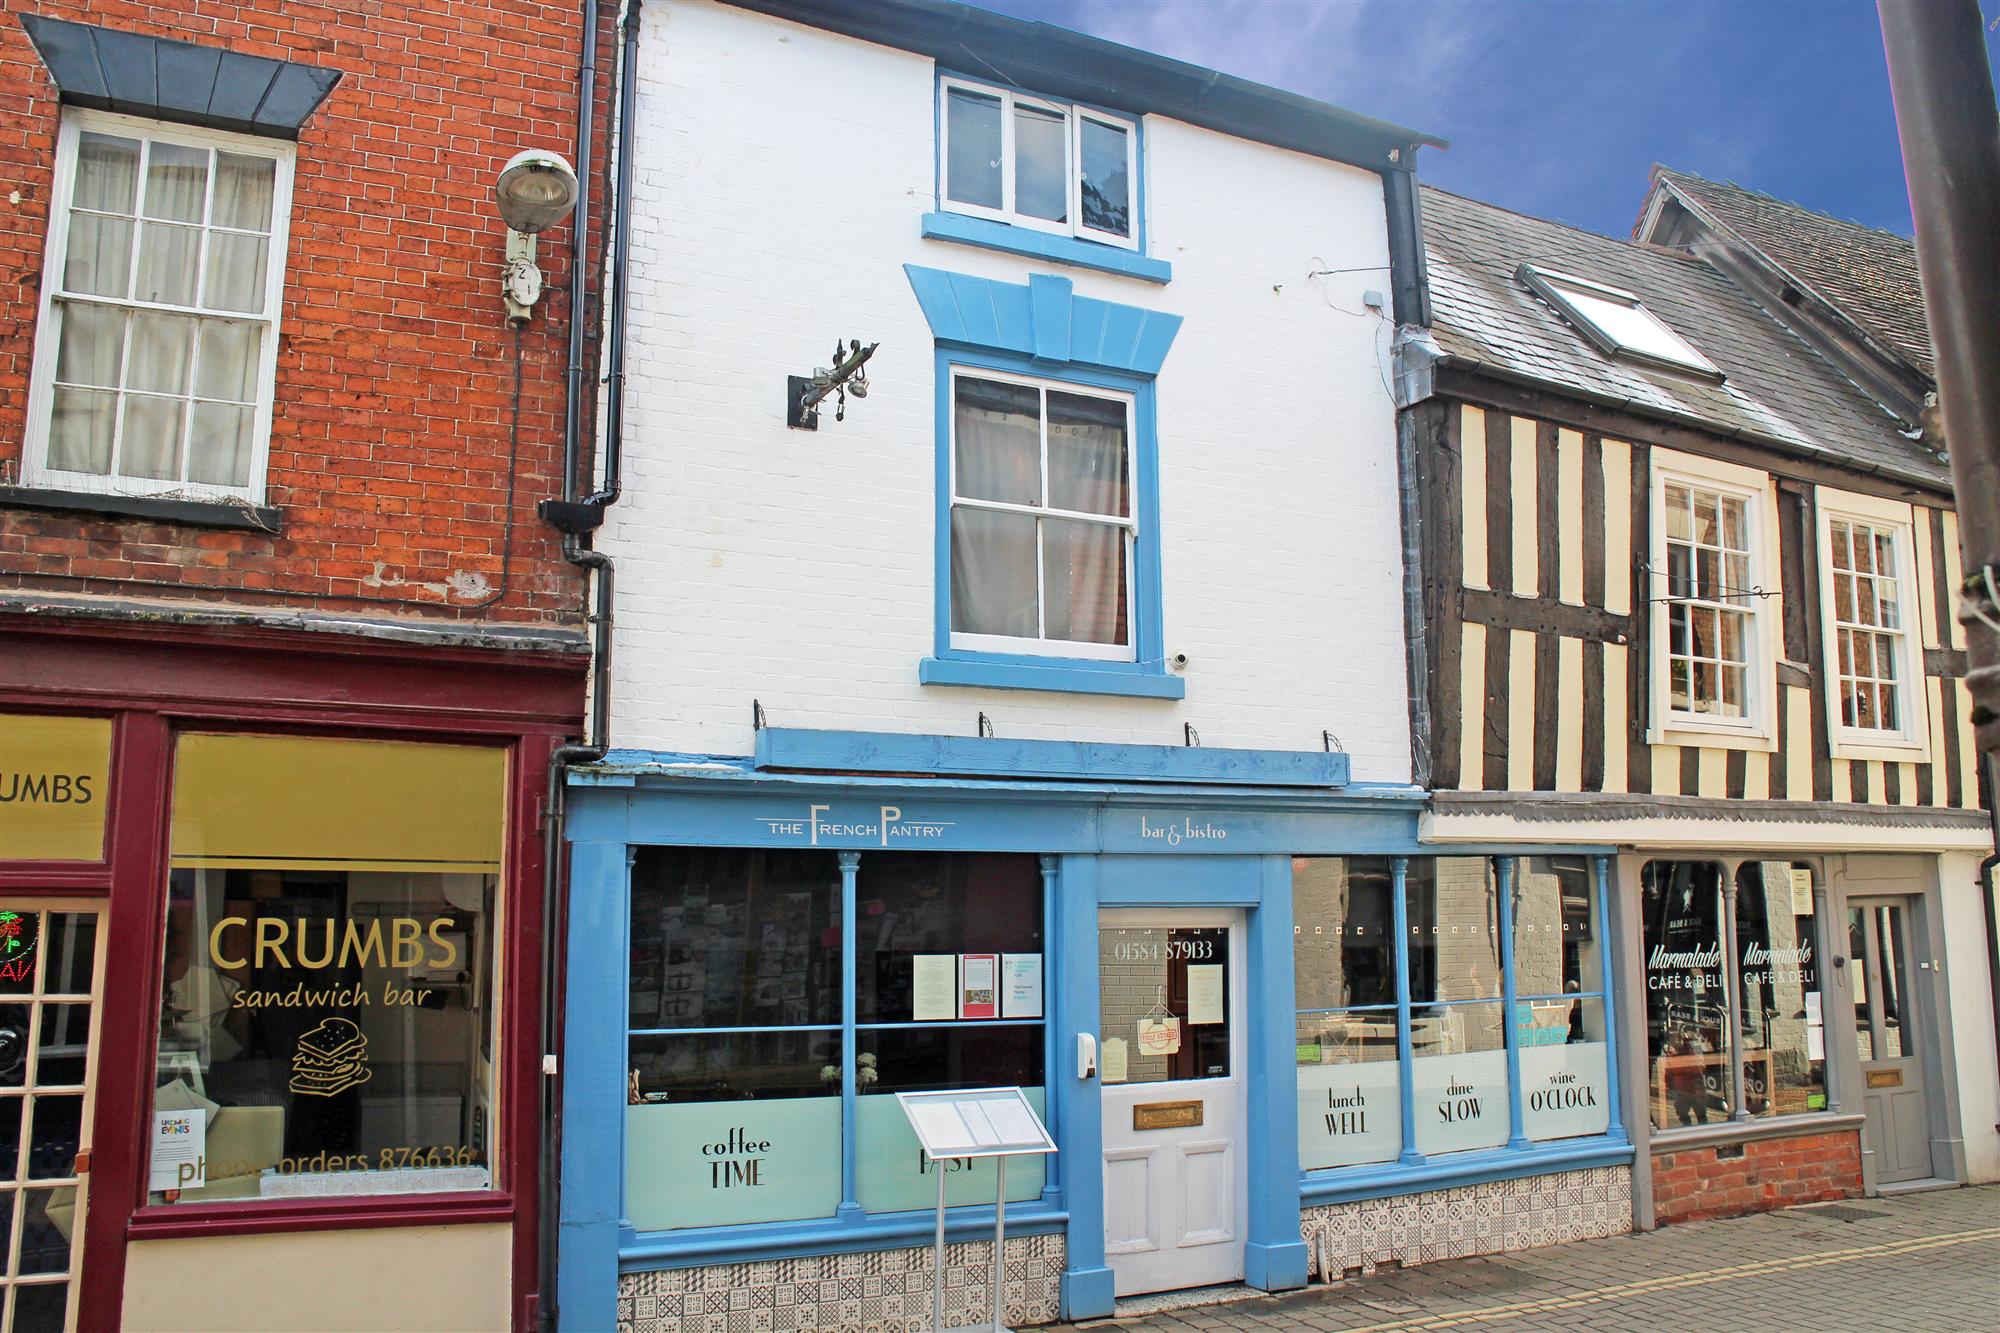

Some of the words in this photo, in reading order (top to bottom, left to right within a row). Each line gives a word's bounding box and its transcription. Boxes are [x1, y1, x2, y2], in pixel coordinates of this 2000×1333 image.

[768, 823, 803, 835] THE
[810, 804, 877, 845] FRENCH
[880, 806, 944, 847] PANTRY
[1142, 816, 1166, 838] bar
[1167, 824, 1183, 846] &
[1185, 816, 1226, 839] bistro
[209, 916, 457, 969] CRUMBS
[1114, 941, 1158, 961] 01584
[1165, 940, 1213, 960] 879133
[1649, 941, 1721, 970] Marmalade
[1743, 938, 1812, 966] Marmalade
[1649, 973, 1681, 990] CAFÉ
[1684, 977, 1693, 988] &
[1696, 974, 1723, 988] DELI
[1744, 969, 1774, 985] CAFÉ
[1777, 973, 1785, 983] &
[1789, 969, 1814, 983] DELI
[232, 981, 370, 1009] sandwich
[383, 980, 432, 1007] bar
[1446, 1075, 1474, 1096] dine
[1549, 1071, 1576, 1085] wine
[1328, 1084, 1365, 1109] lunch
[1530, 1086, 1597, 1112] O'CLOCK
[1325, 1110, 1370, 1136] WELL
[1438, 1097, 1483, 1124] SLOW
[702, 1126, 771, 1155] coffee
[278, 1150, 369, 1175] orders
[379, 1144, 472, 1171] 876636
[708, 1158, 766, 1188] TIME
